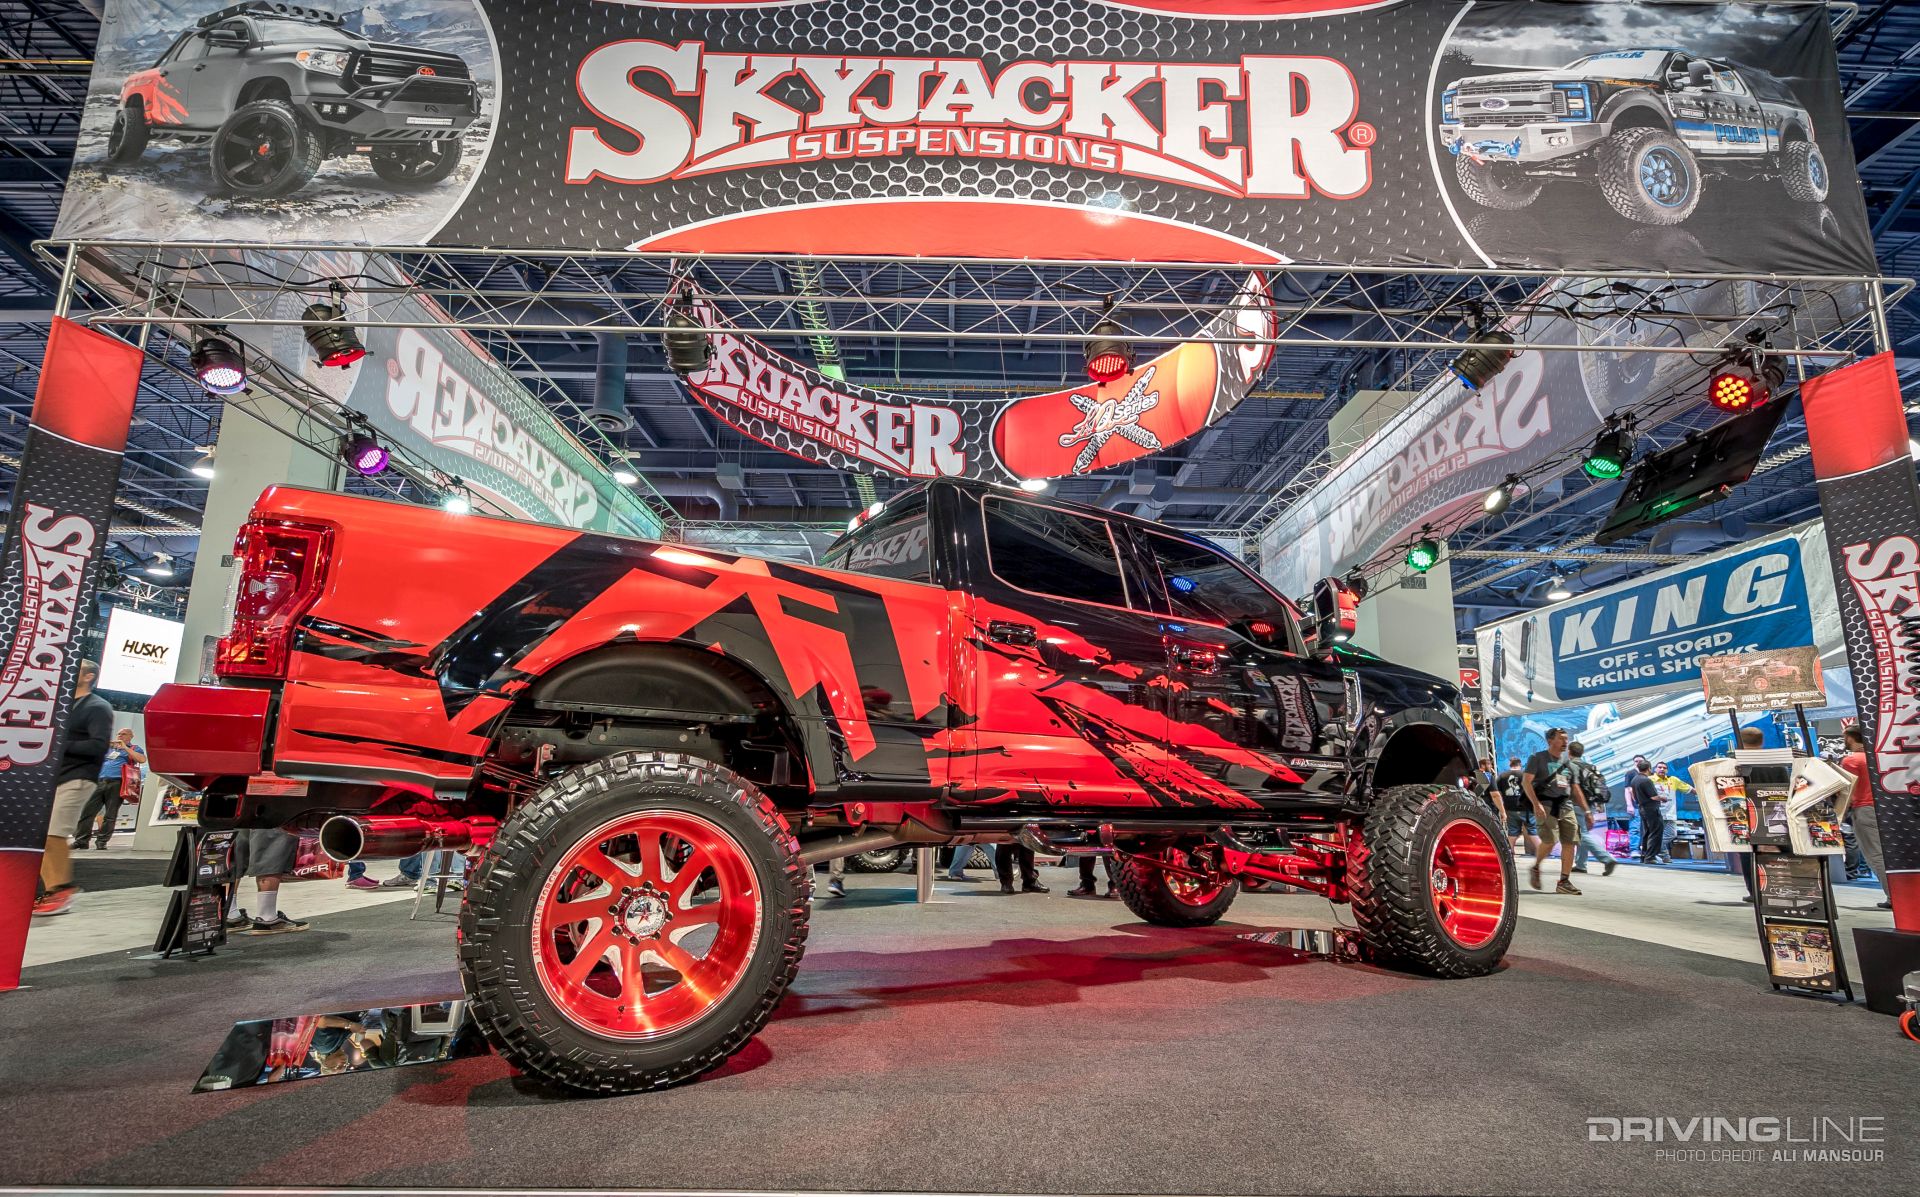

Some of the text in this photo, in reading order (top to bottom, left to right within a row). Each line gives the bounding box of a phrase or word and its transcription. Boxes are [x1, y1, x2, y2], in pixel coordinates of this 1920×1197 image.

[566, 39, 1372, 199] SKYJACKER
[795, 126, 1121, 172] SUSPENSIONS
[1713, 122, 1760, 144] POLICE
[687, 288, 966, 478] KYJACKER
[737, 388, 857, 455] SUSPENSIONS
[1, 576, 40, 684] SUSPENSIONS
[1559, 553, 1790, 657] KING
[122, 640, 169, 659] HUSKY
[1577, 664, 1656, 689] RACING
[1599, 650, 1640, 669] OFF
[1658, 632, 1733, 657] ROAD
[1867, 608, 1895, 714] SUSPENSIONS
